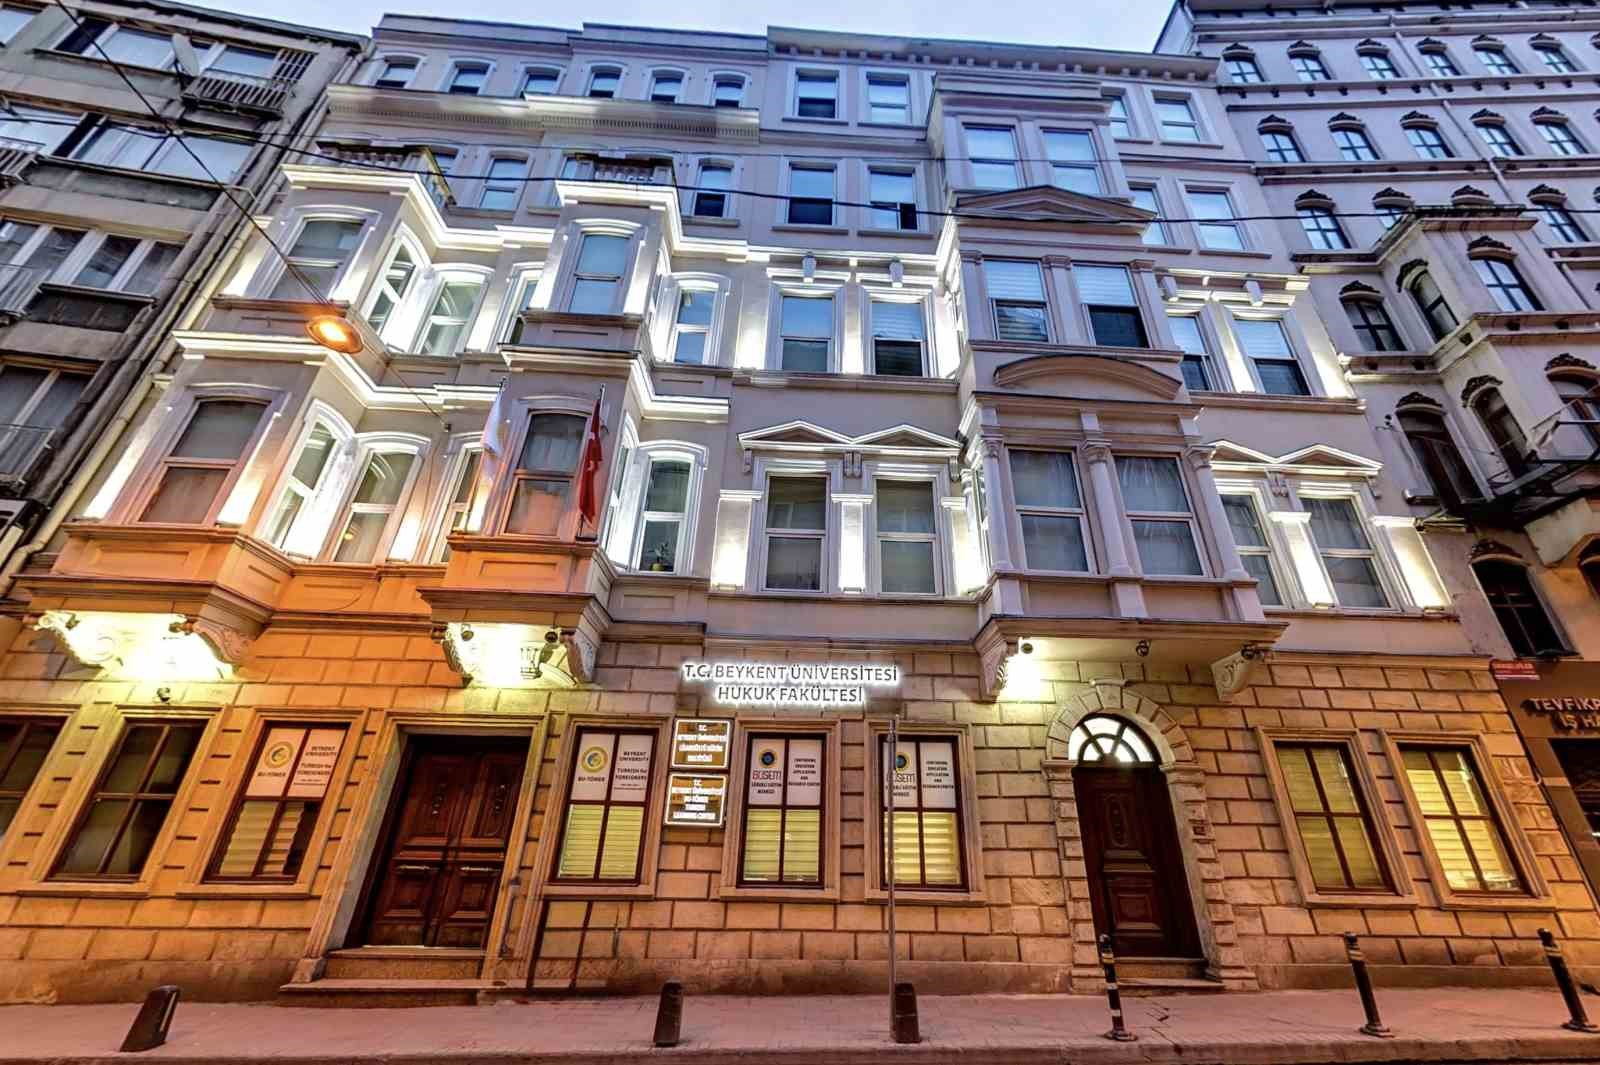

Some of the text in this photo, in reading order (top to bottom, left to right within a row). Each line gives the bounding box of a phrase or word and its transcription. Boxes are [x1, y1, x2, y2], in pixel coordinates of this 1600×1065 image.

[684, 664, 897, 681] T.C. BEYKENT ÜNİVERSİTESİ
[718, 685, 862, 702] HUKUK FAKÜLTESİ
